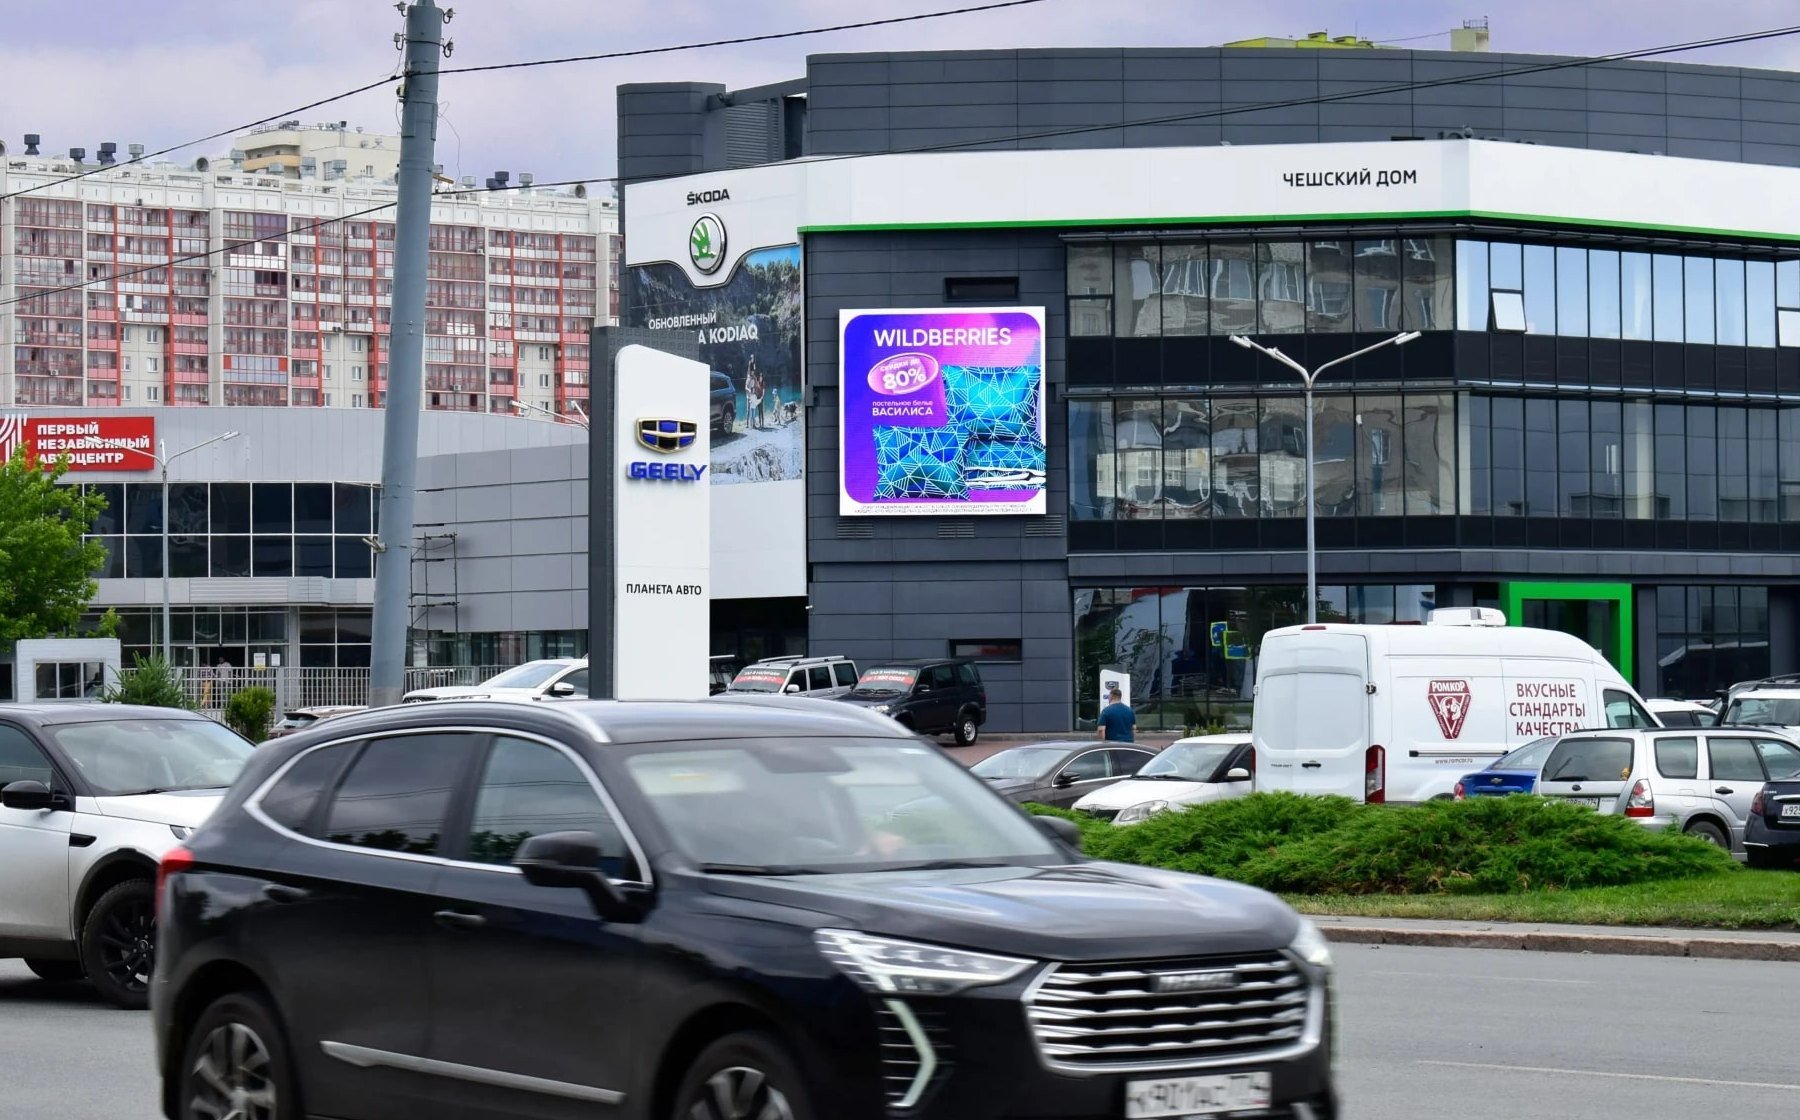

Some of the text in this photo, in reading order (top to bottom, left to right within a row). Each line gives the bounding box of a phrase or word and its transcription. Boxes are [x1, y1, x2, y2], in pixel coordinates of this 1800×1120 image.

[1283, 168, 1417, 187] ЧЕШСКИЙ ДОМ
[687, 188, 730, 206] ŠKODA
[648, 309, 717, 330] ОБНОВЛЕННЫЙ
[709, 324, 759, 344] KODIAQ
[873, 327, 1012, 347] WILDBERRIES
[883, 366, 927, 390] 80%
[872, 407, 933, 416] ВАСИЛИСА
[37, 421, 99, 435] ПЕРВЫЙ
[37, 435, 150, 450] НЕЗАВИСИМЫЙ
[628, 461, 708, 481] GEELY
[626, 583, 702, 596] ПЛАНЕТА АВТО
[1431, 680, 1466, 693] РОМКОР
[1516, 683, 1576, 698] ВКУСНЫЕ
[1509, 702, 1586, 719] СТАНДАРТЫ
